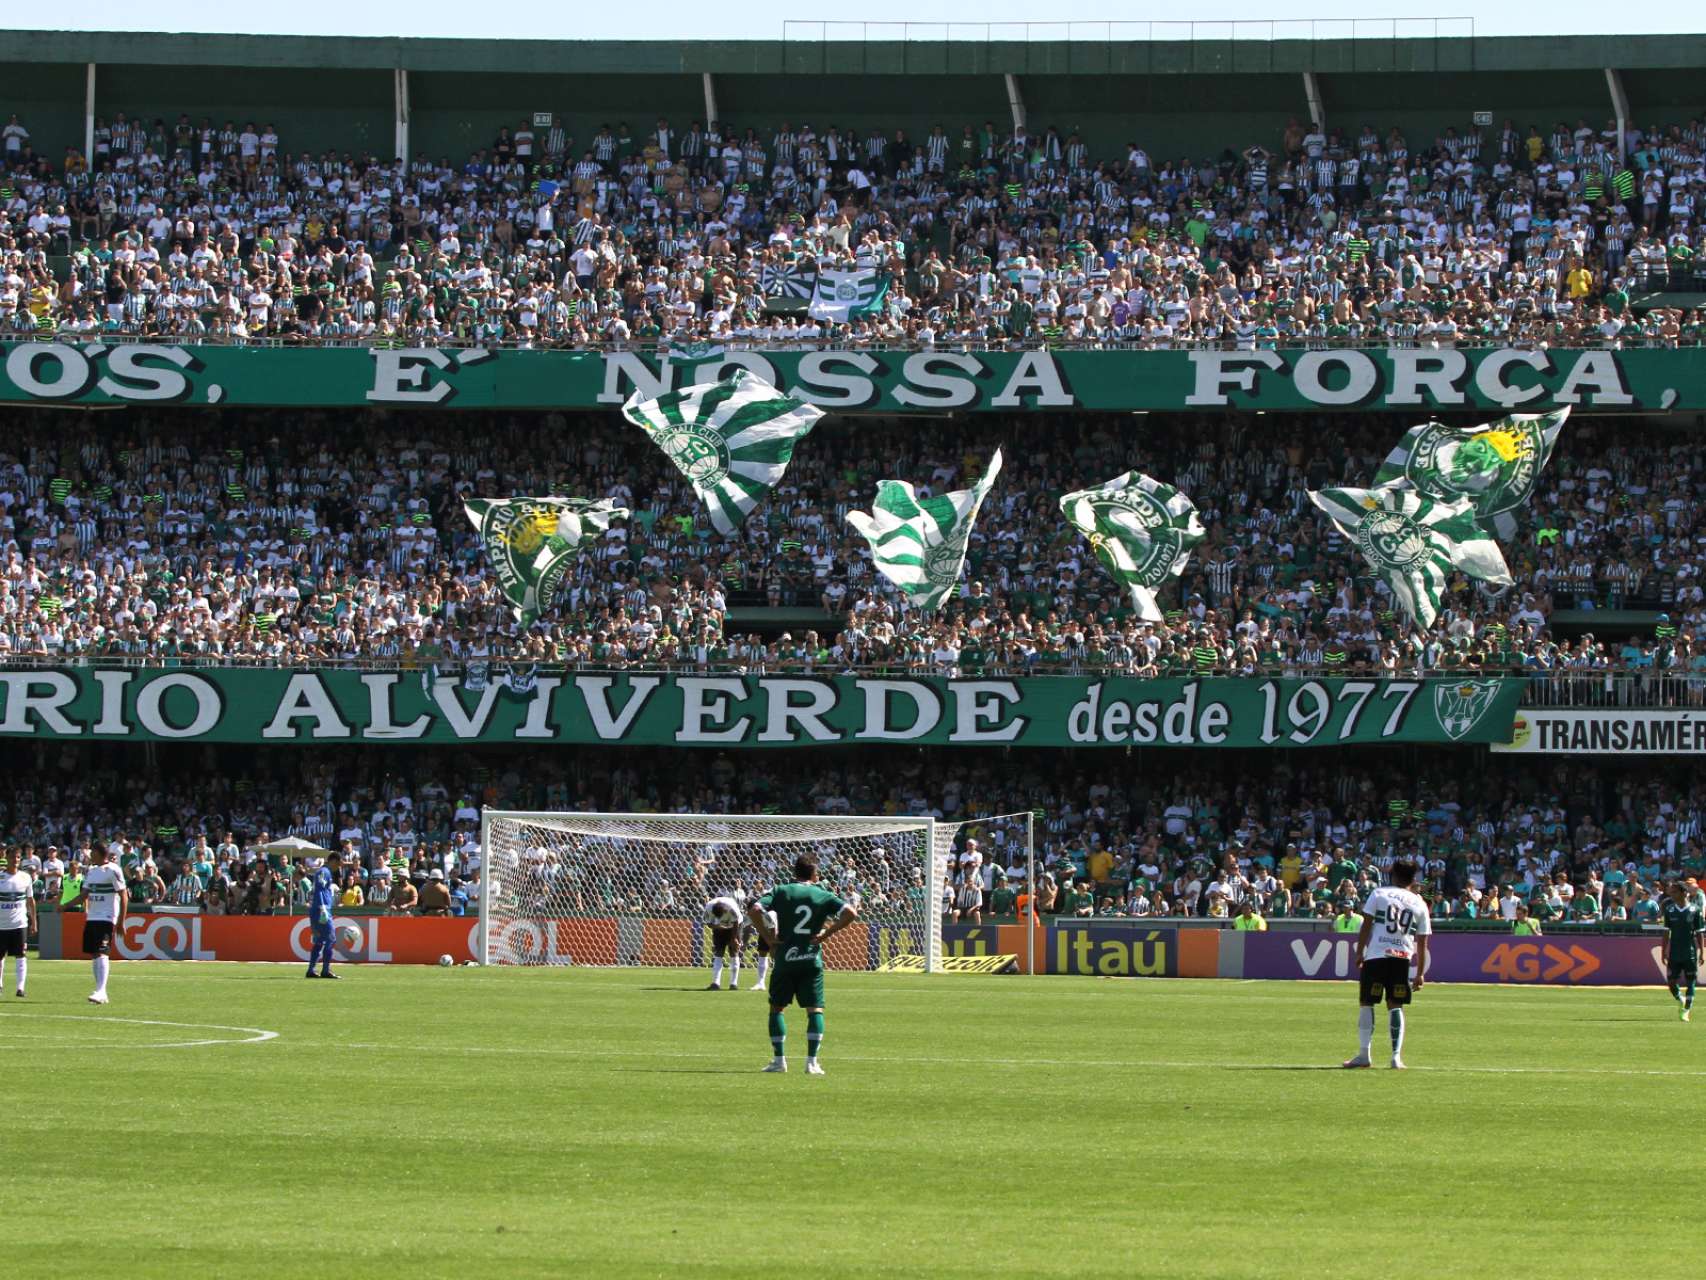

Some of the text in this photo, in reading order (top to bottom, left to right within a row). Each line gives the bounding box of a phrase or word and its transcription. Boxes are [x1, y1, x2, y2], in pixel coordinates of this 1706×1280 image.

[597, 351, 1074, 407] NOSSA
[698, 427, 723, 447] CLUB
[262, 673, 1023, 741] ALVIVERDE
[1068, 682, 1228, 744] desde
[1258, 680, 1421, 744] 1977
[115, 917, 216, 960] GOL
[793, 905, 813, 934] 2
[1386, 903, 1413, 935] 99
[1057, 930, 1166, 975] Itaú
[1481, 943, 1539, 981] 4G
